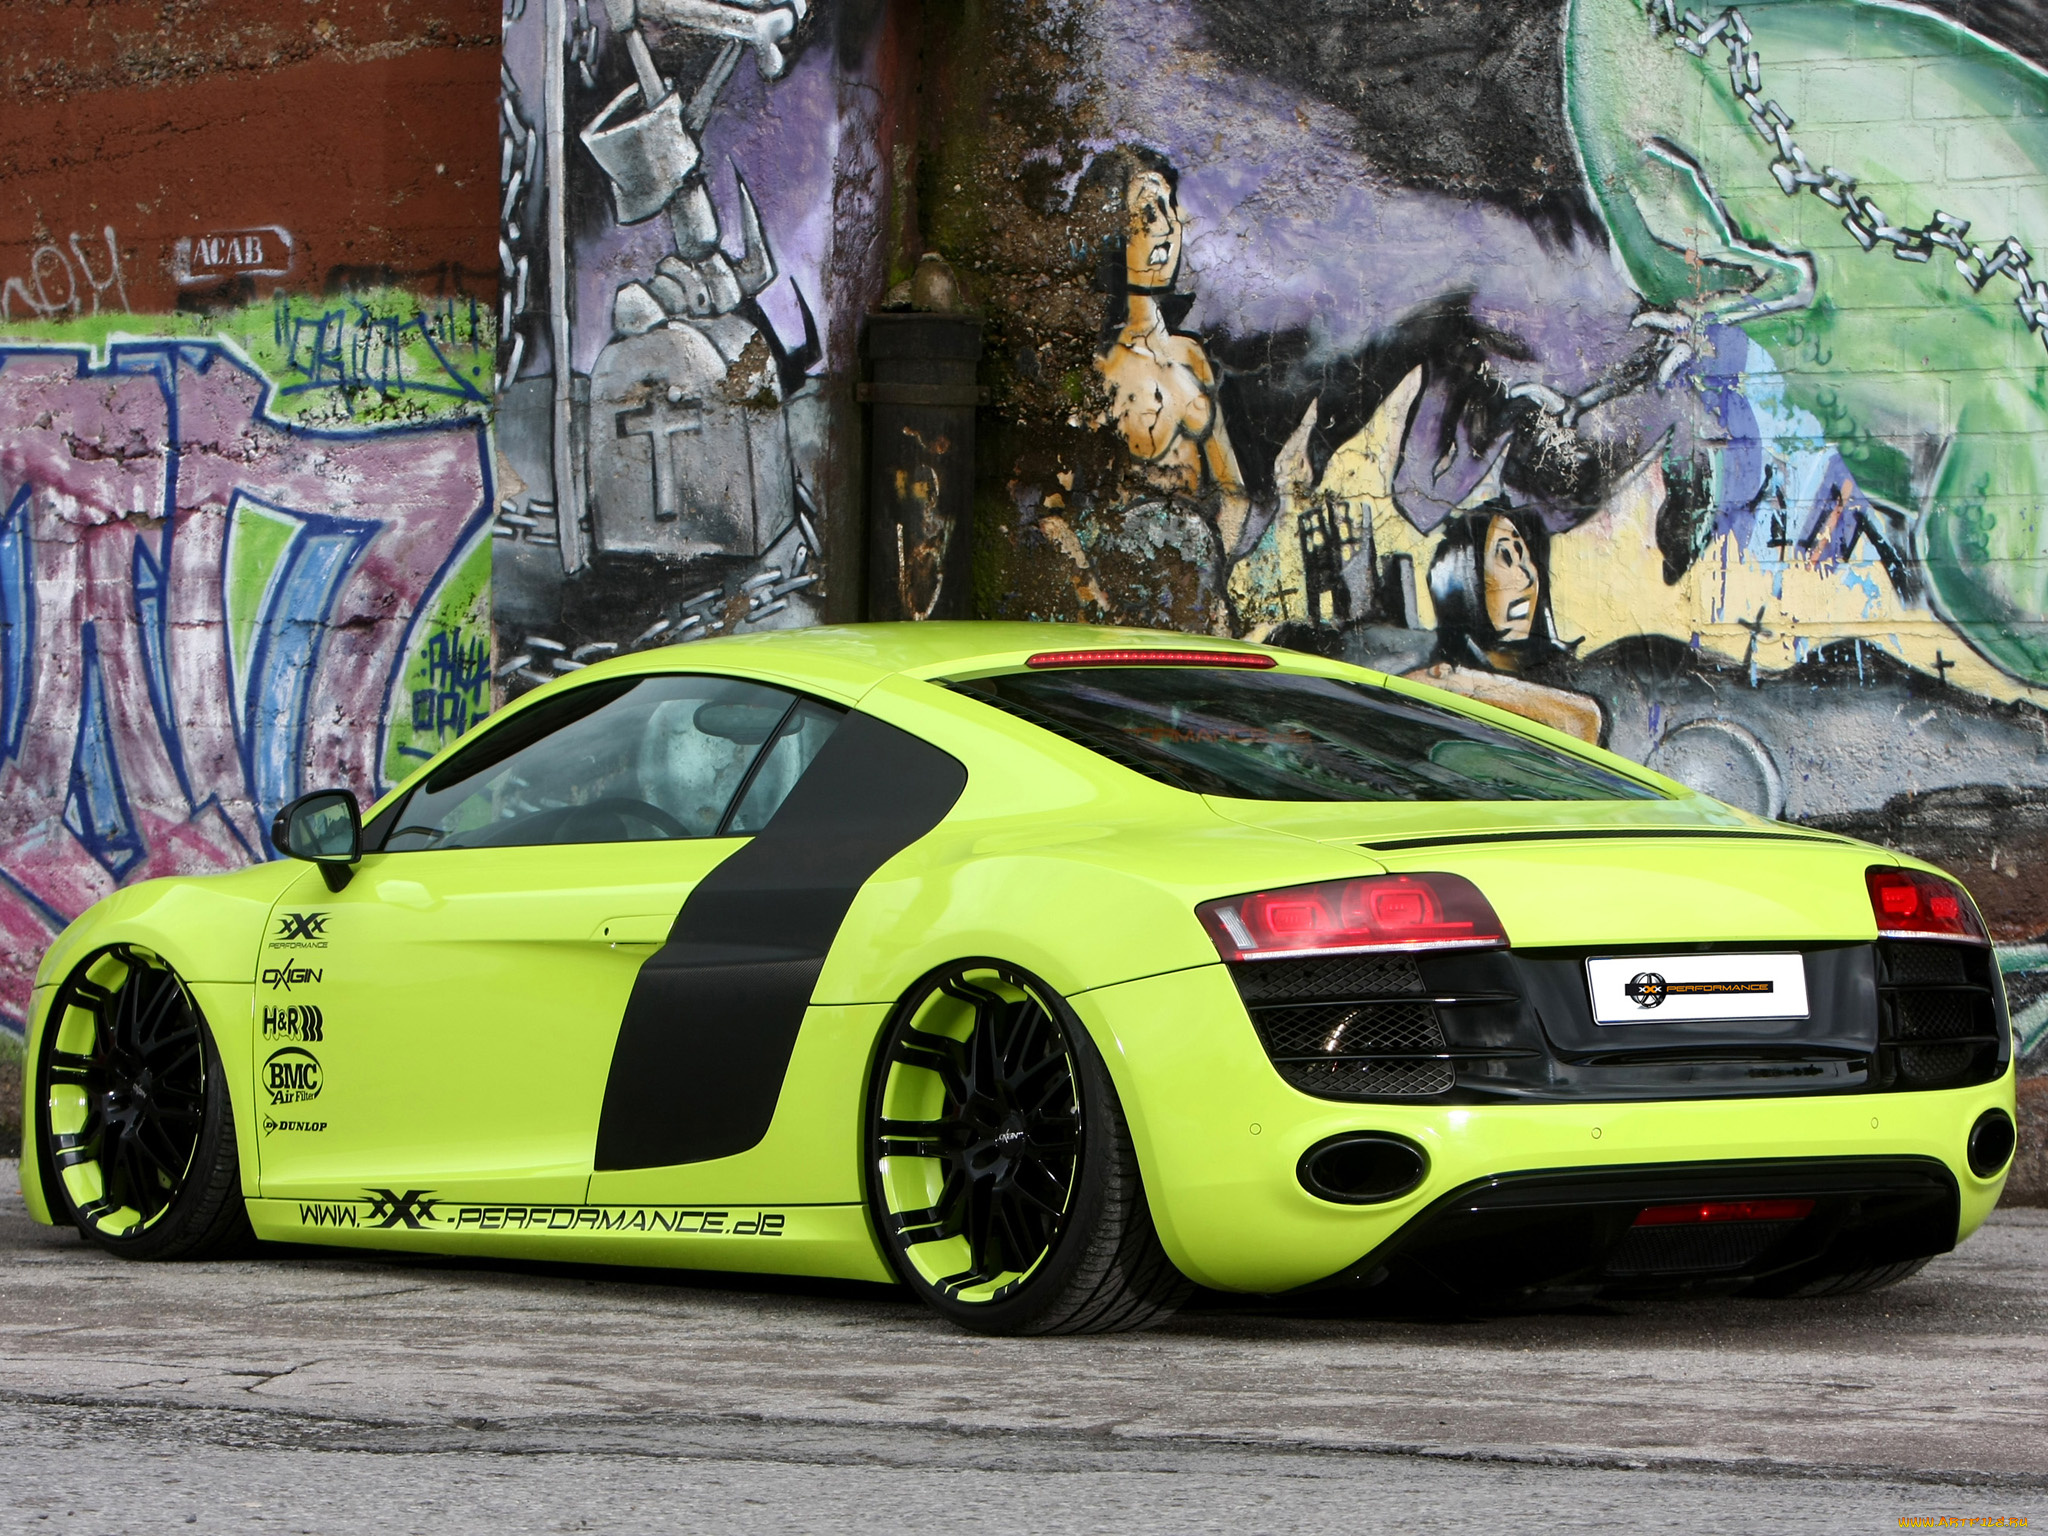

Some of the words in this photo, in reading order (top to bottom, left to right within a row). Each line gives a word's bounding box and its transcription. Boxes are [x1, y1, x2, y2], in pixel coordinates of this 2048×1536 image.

[193, 236, 263, 266] ACAB
[1666, 983, 1769, 993] PERFORMANCE
[263, 1006, 300, 1038] H&R
[269, 1063, 318, 1090] BMC
[271, 1090, 295, 1105] Air
[295, 1090, 316, 1101] Filter
[278, 1121, 328, 1132] DUNLOP
